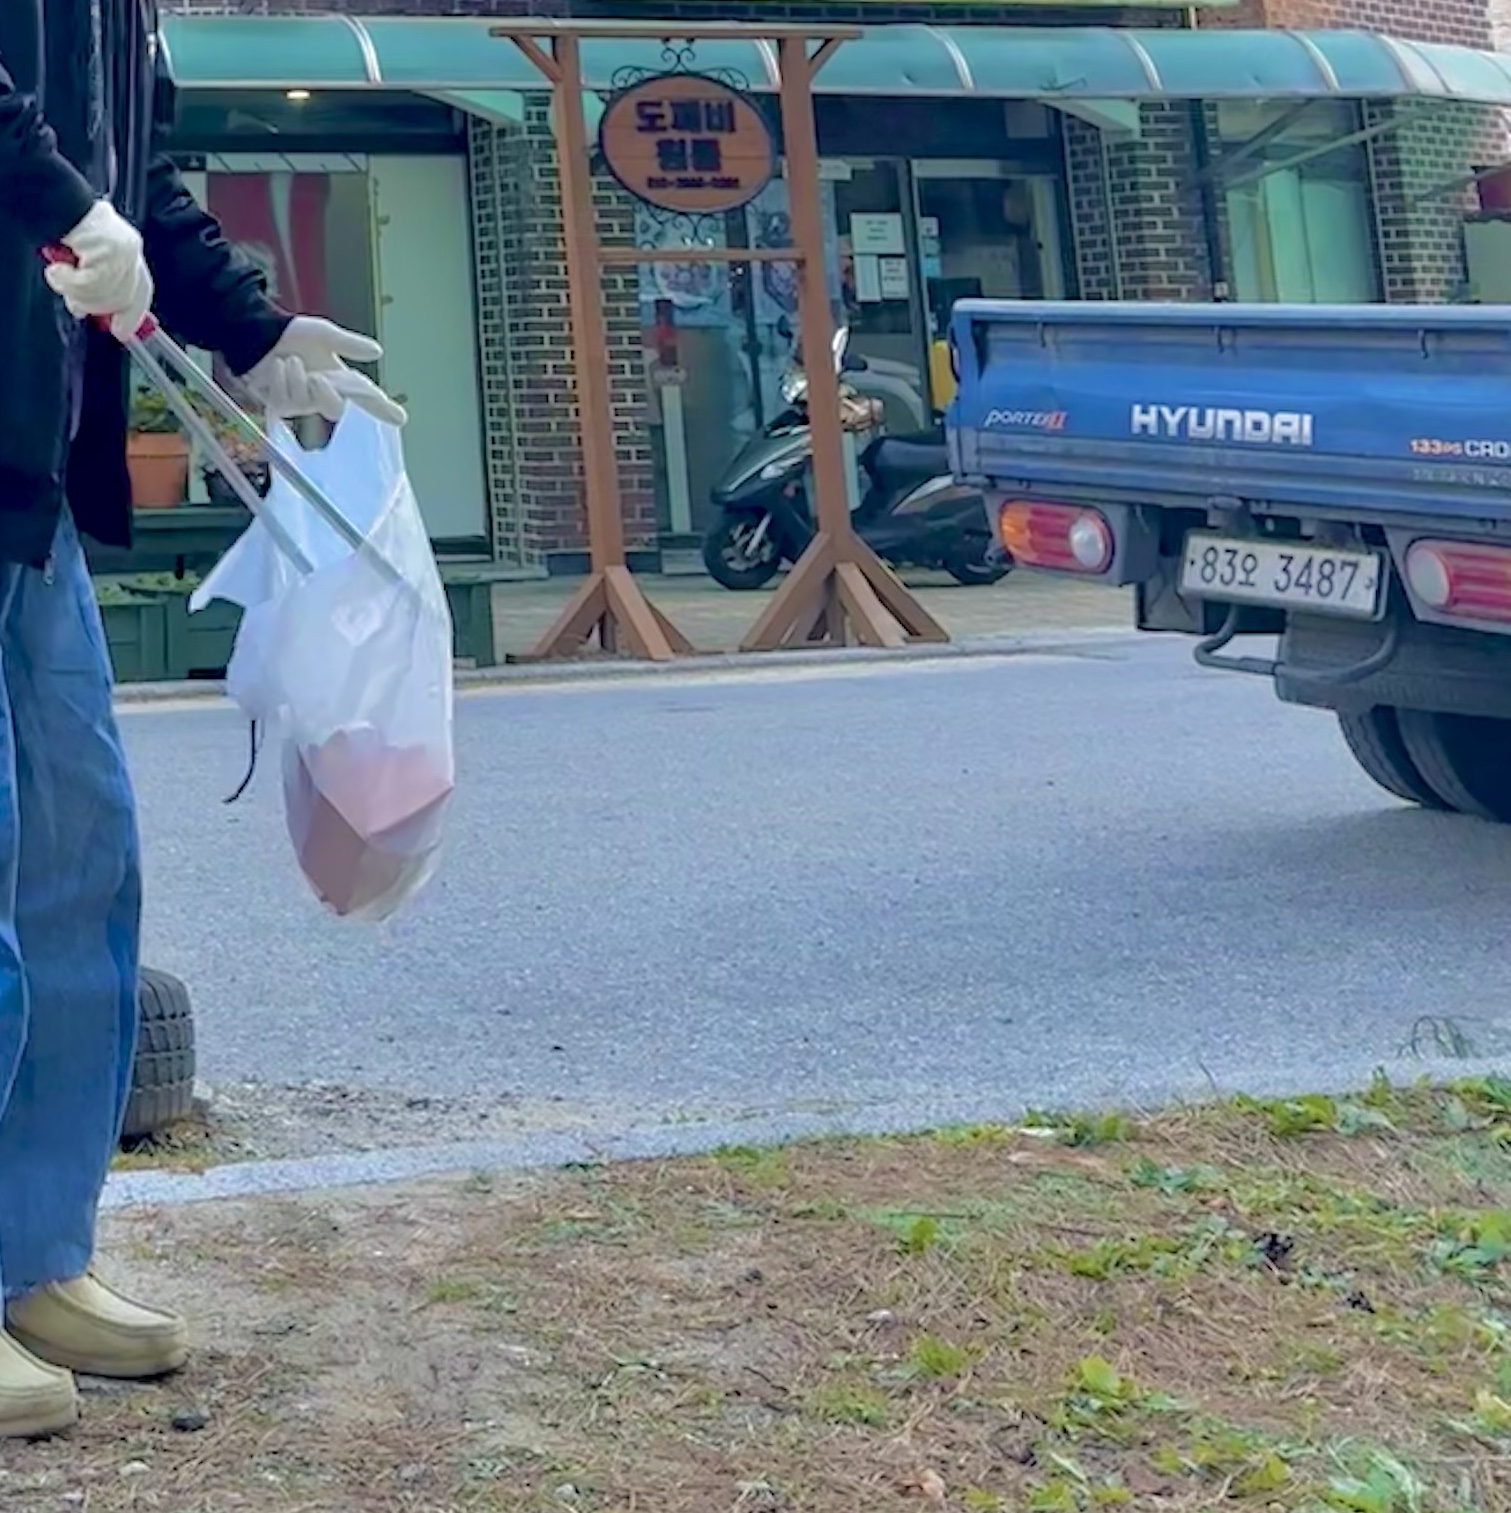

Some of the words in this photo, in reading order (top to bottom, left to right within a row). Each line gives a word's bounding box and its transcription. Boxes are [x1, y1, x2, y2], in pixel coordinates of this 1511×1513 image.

[1130, 404, 1314, 446] HYUNDAI
[1201, 546, 1258, 587] 83오
[1273, 553, 1360, 601] 3487
